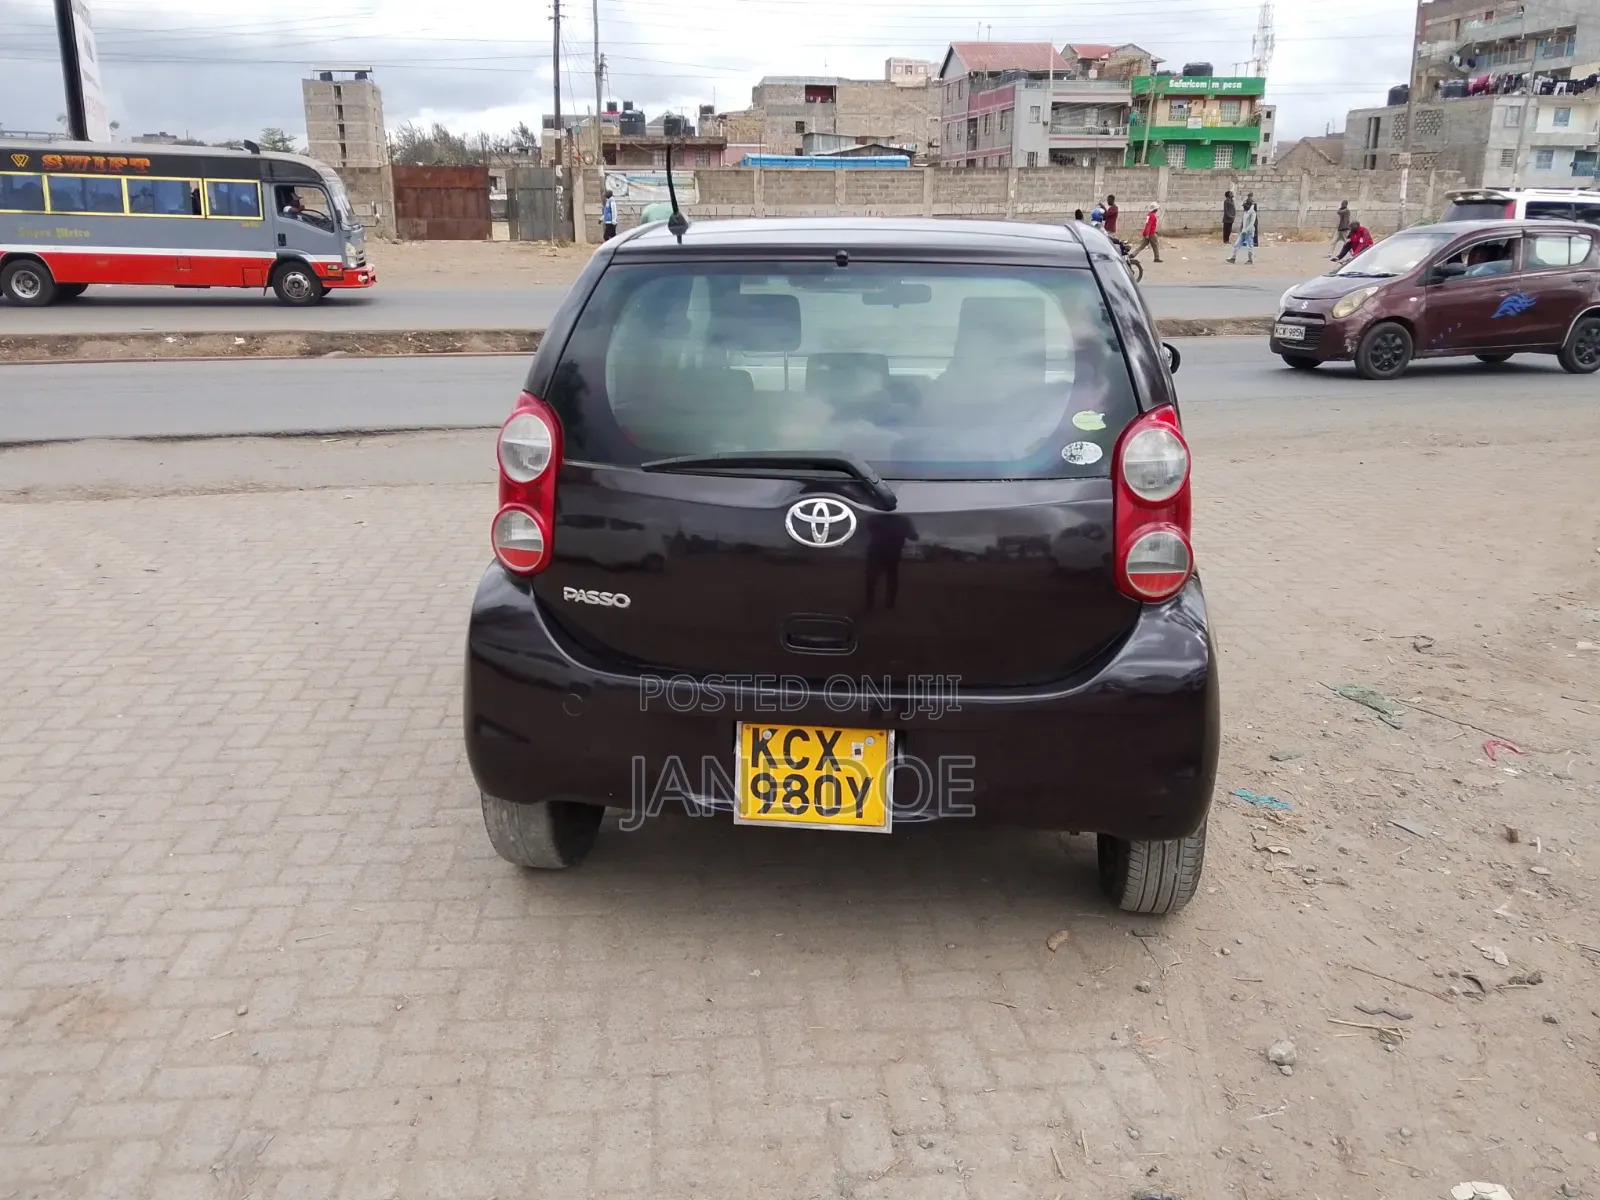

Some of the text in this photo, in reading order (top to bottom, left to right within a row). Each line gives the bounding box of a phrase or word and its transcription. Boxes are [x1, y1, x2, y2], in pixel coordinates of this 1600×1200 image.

[1169, 79, 1207, 88] Safaricom
[42, 154, 150, 173] SWIFT
[563, 586, 631, 608] PASSO
[751, 727, 843, 772] KCX
[750, 773, 873, 819] 980Y
